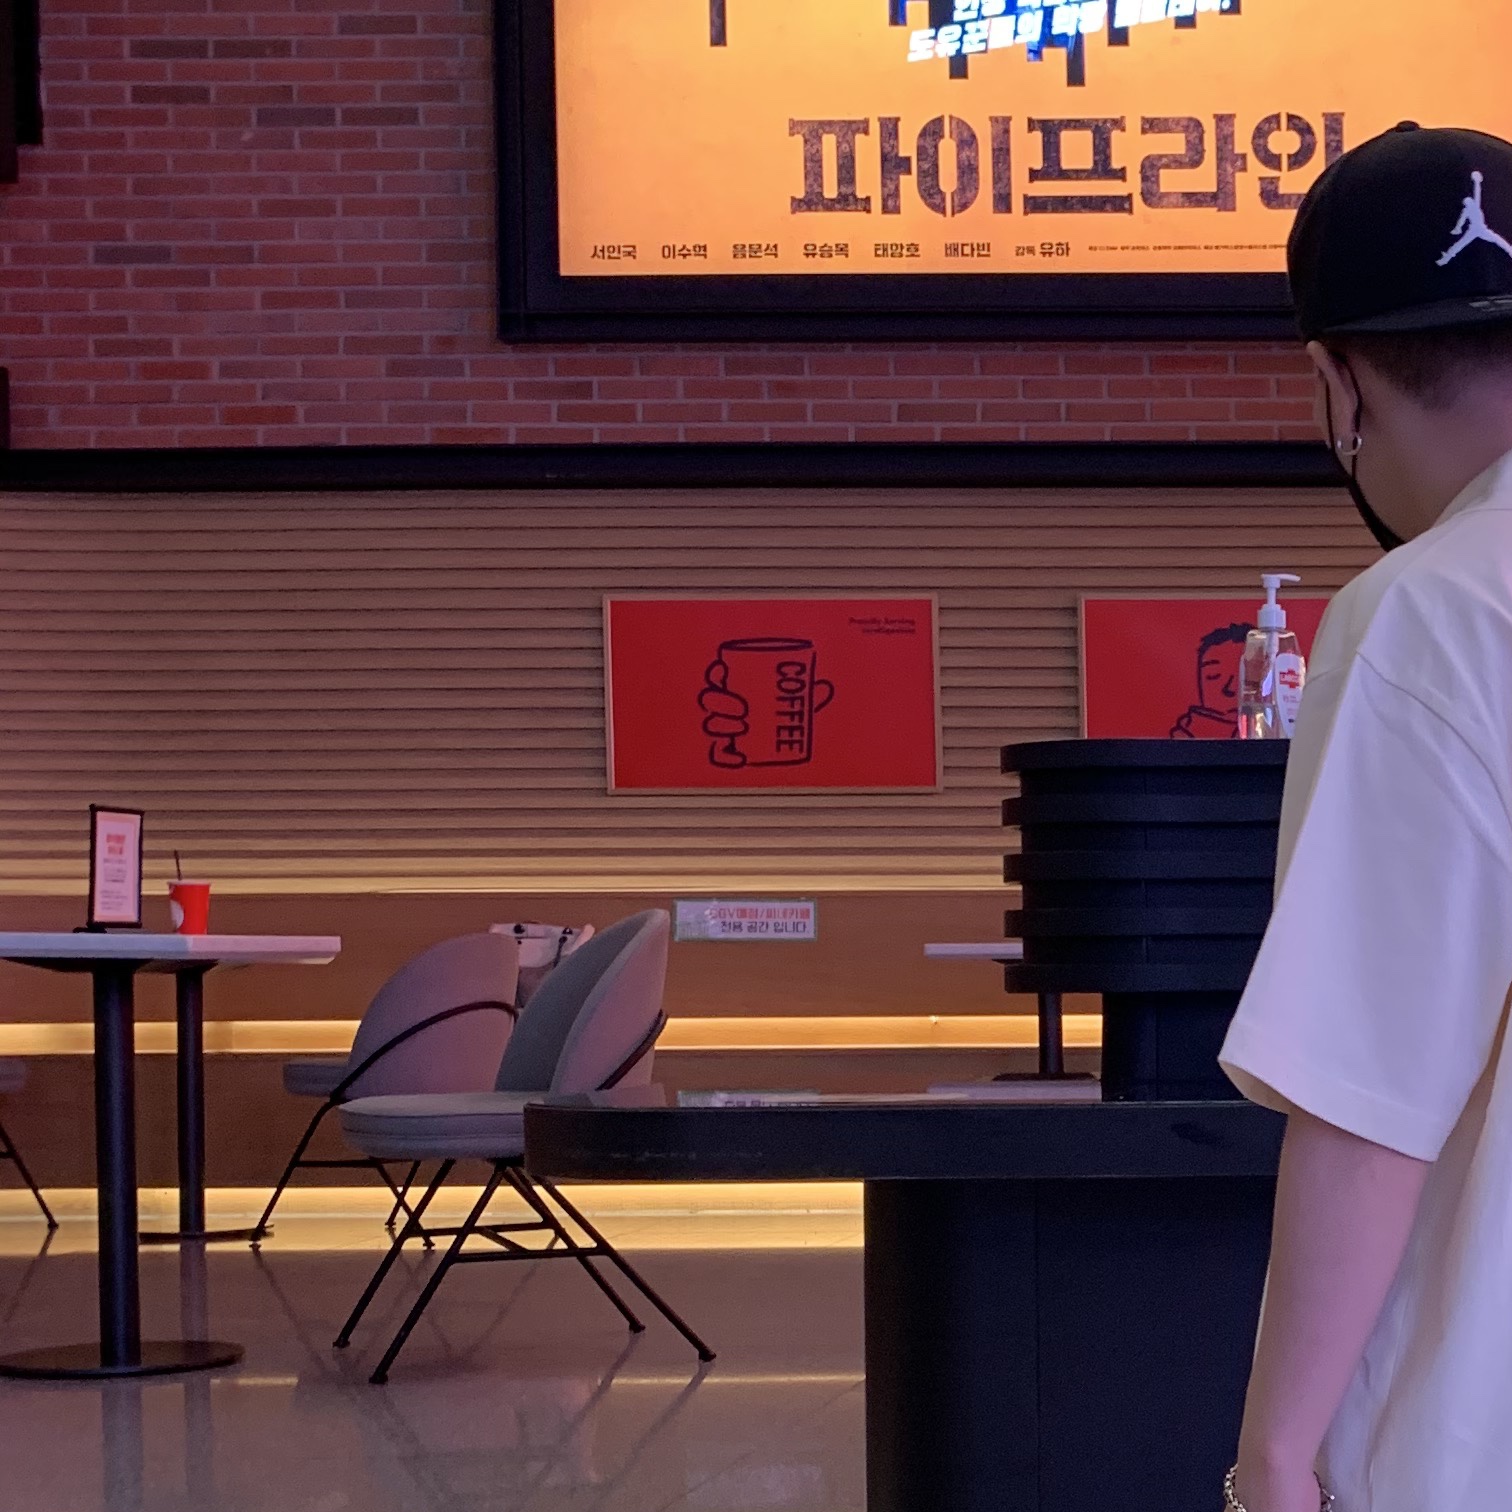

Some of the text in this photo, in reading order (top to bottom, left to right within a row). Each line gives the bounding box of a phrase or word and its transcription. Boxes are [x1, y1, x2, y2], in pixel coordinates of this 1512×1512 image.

[788, 111, 1346, 218] 파이프라인
[590, 244, 637, 260] 서인국
[661, 243, 708, 260] 이수혁
[732, 243, 779, 259] 음문석
[803, 243, 850, 259] 유승목
[944, 242, 992, 258] 배다빈
[1014, 245, 1036, 257] 감독
[1039, 241, 1071, 258] 유하
[775, 661, 807, 754] COFFEE
[720, 921, 743, 934] 전용
[747, 921, 769, 934] 공간
